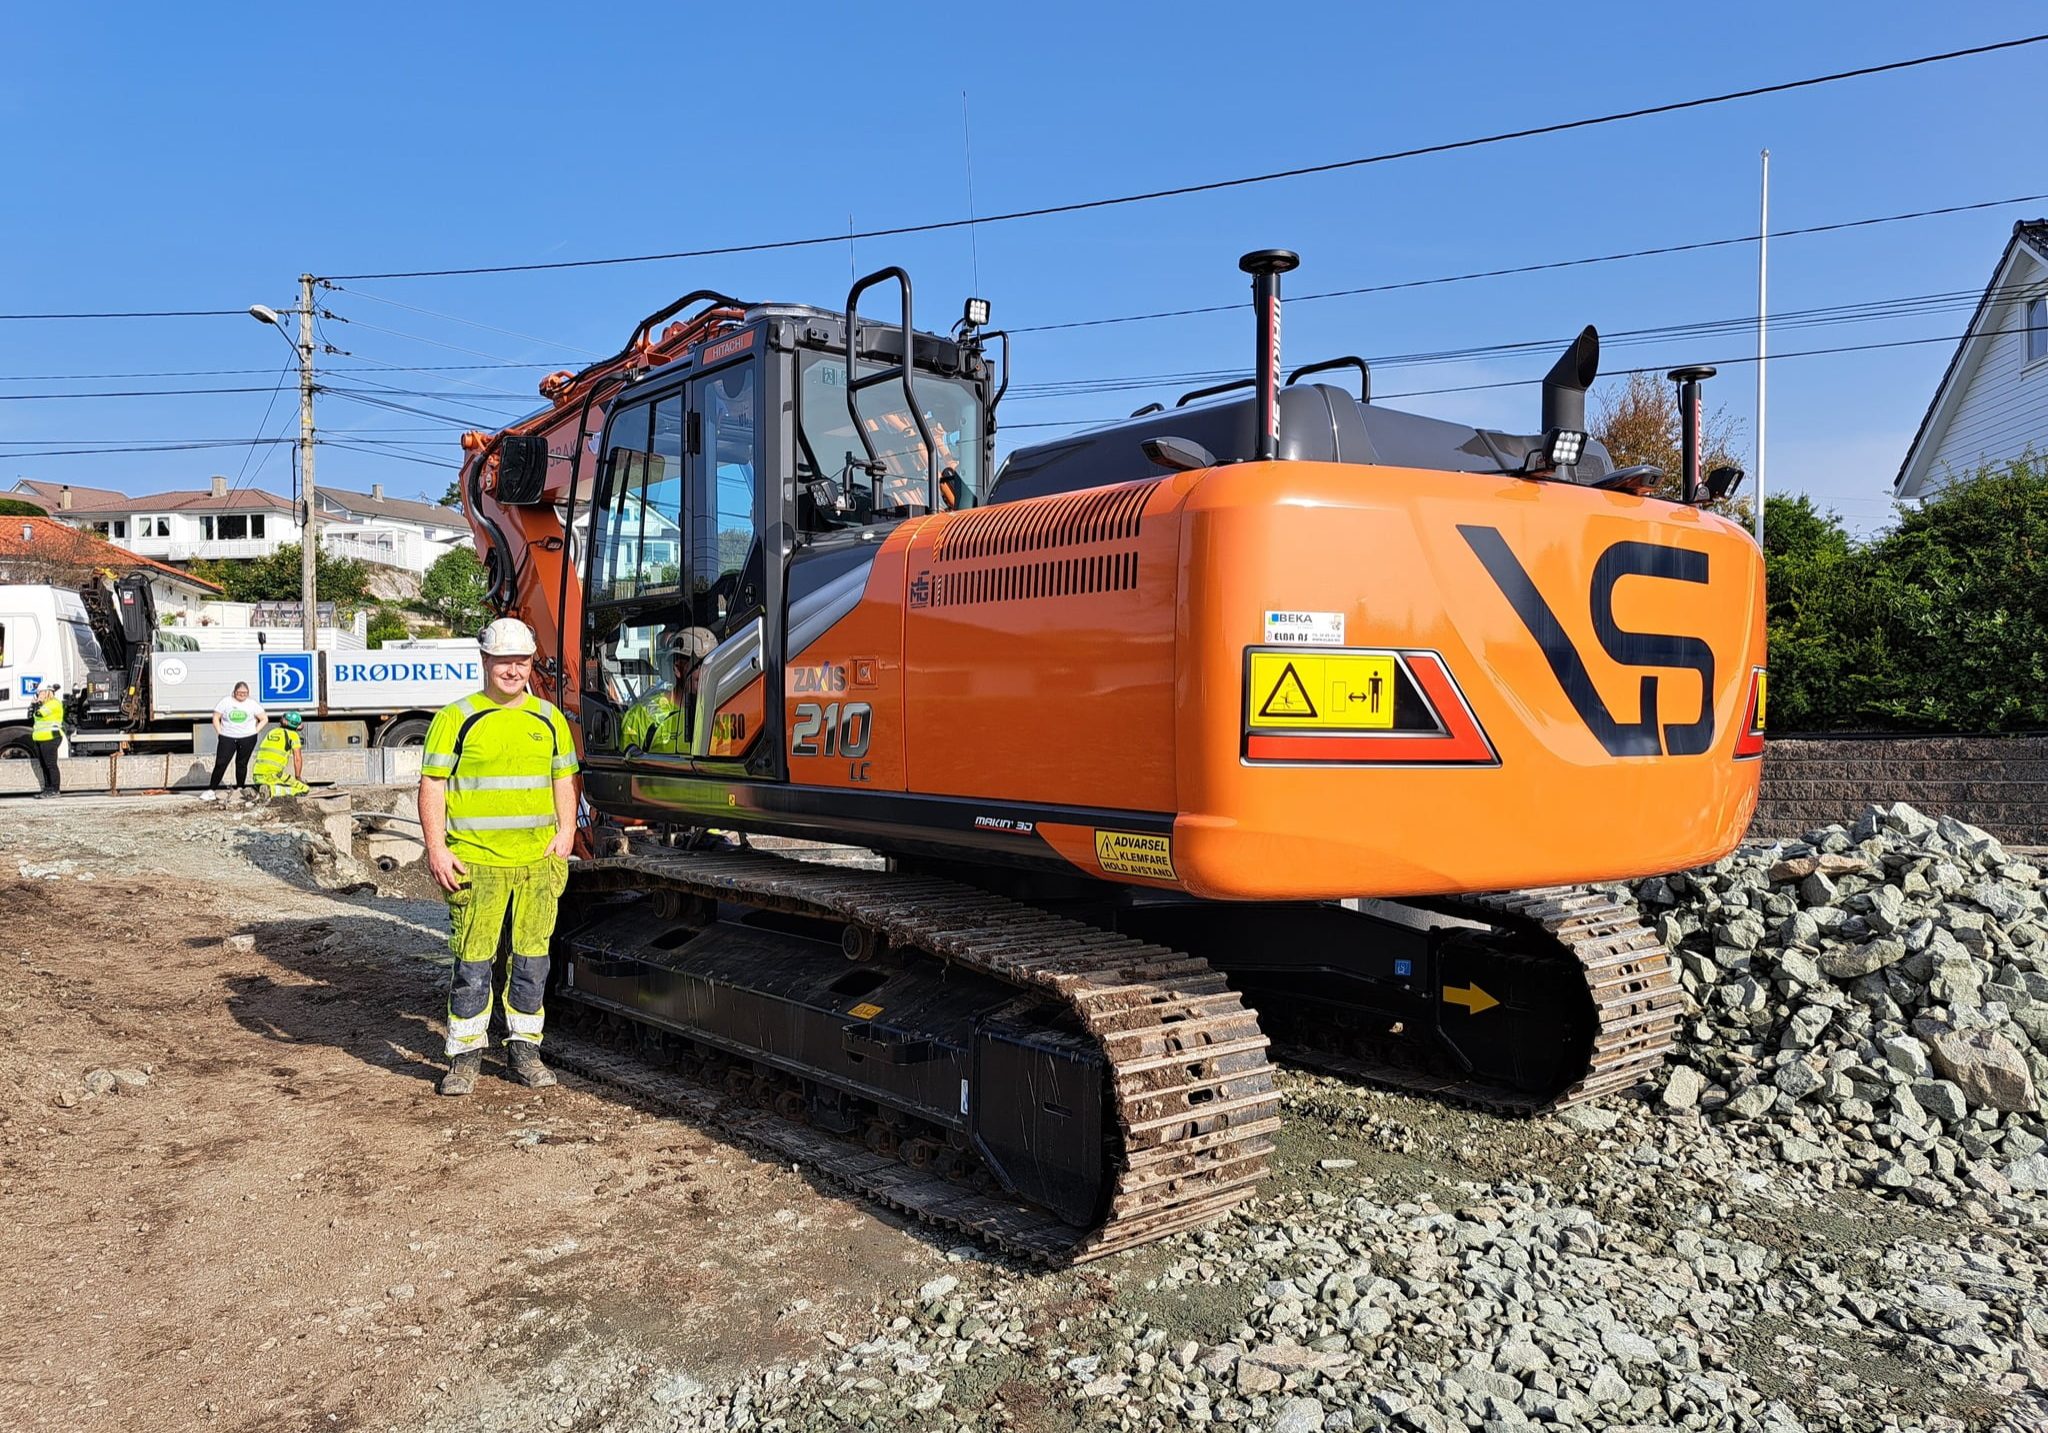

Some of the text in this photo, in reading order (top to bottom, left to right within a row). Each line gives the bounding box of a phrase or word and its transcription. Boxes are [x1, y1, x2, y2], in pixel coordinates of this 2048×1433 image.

[712, 336, 744, 357] HITACHI
[1279, 613, 1313, 623] BEKA
[1274, 632, 1295, 642] ELBA
[1297, 633, 1308, 642] AS
[334, 662, 479, 682] BRØDRENE
[793, 661, 846, 692] ZAXIS
[791, 702, 873, 758] 210
[849, 761, 873, 782] LC
[1016, 820, 1033, 832] 3D
[1113, 836, 1167, 852] ADVARSEL
[1119, 851, 1169, 866] KLEMFARE
[1102, 861, 1173, 878] HOLD AVSTAND
